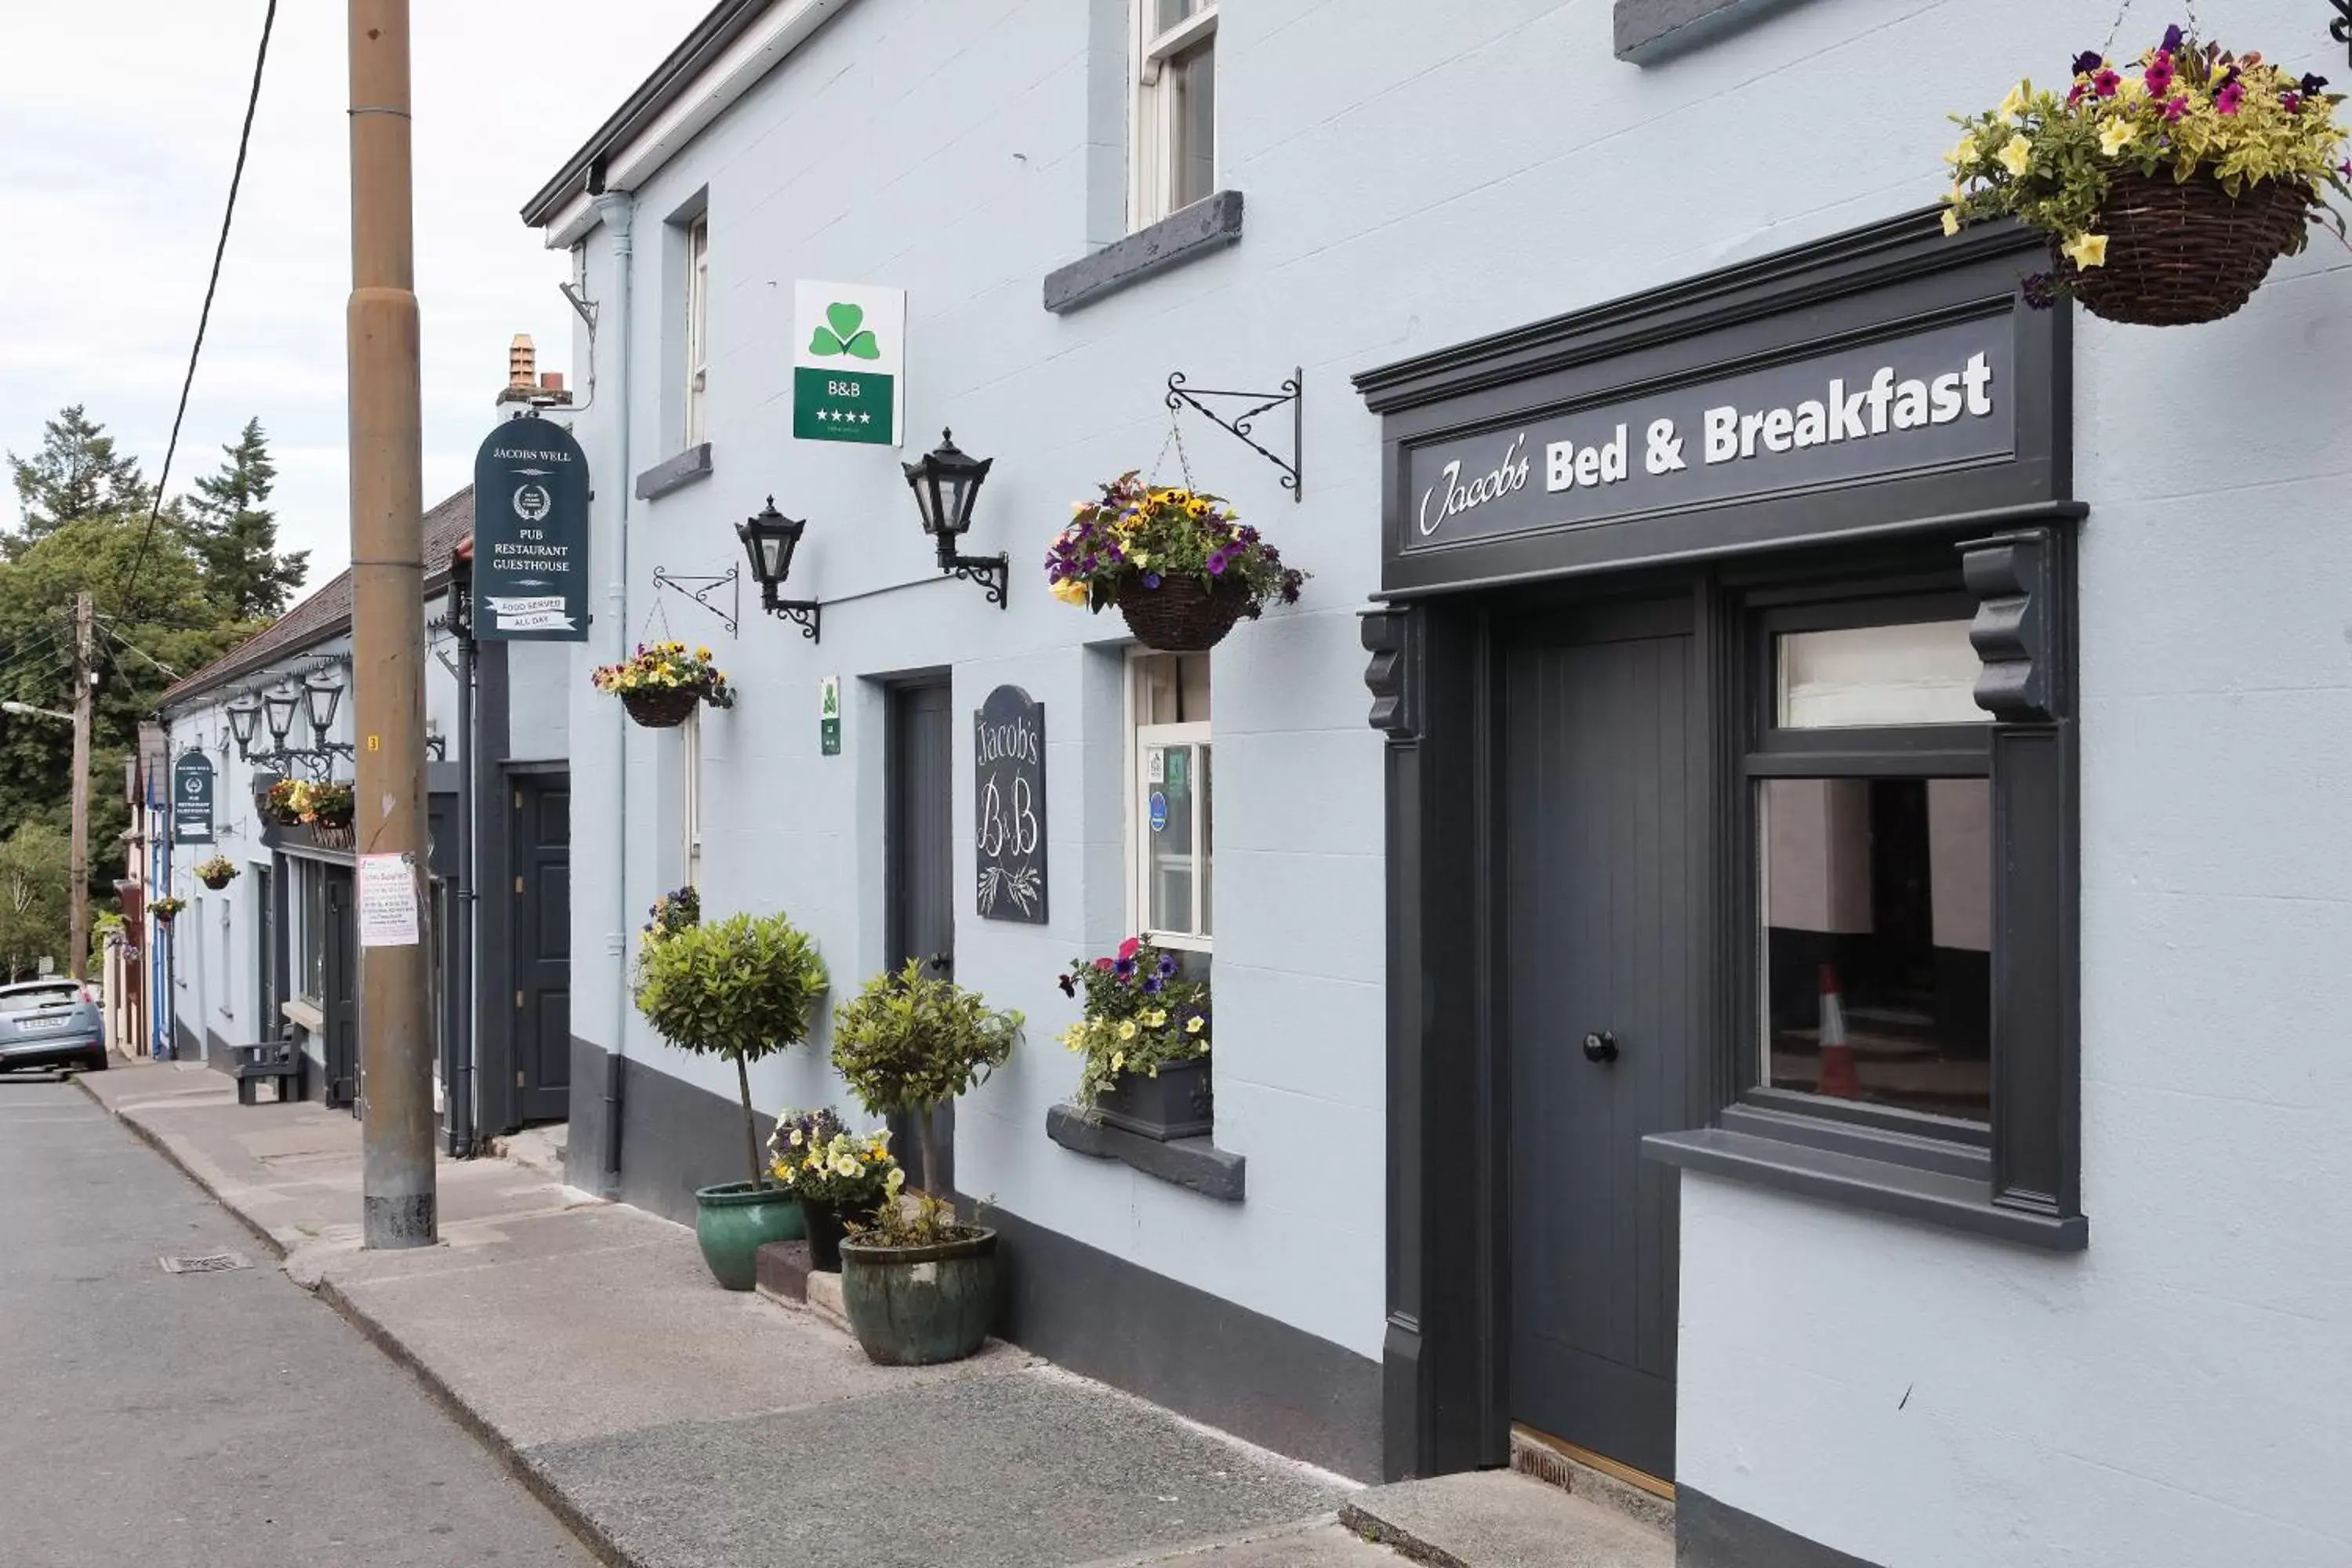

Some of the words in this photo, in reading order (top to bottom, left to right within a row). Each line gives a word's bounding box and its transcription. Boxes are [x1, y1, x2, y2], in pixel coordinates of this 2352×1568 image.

[828, 380, 860, 397] B&B
[1420, 432, 1530, 535] Jacob's
[1546, 423, 1628, 492] Bed
[1646, 418, 1687, 475] &
[1704, 351, 1991, 465] Breakfast
[539, 451, 572, 462] WELL
[520, 529, 543, 540] PUB
[495, 543, 568, 556] RESTAURANT
[493, 559, 570, 572] GUESTHOUSE
[978, 716, 1037, 765] Jacob's
